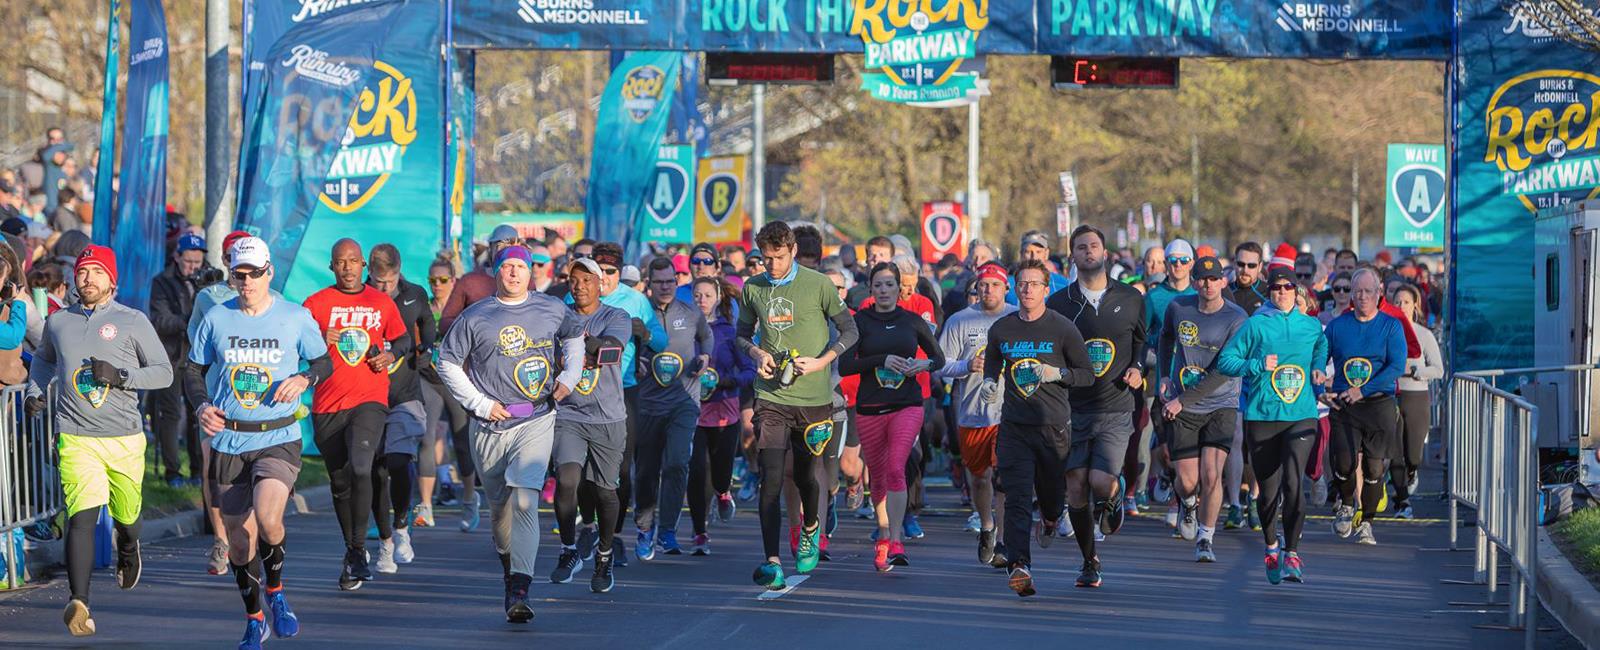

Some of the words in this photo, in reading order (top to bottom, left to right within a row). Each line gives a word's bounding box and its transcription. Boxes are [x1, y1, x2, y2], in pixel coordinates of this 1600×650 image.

[537, 0, 594, 9] BURNS
[1296, 4, 1352, 18] BURNS
[702, 0, 789, 31] ROCK
[1051, 0, 1216, 36] PARKWAY
[868, 31, 972, 67] PARKWAY
[282, 44, 361, 86] Running
[924, 67, 935, 79] 5K
[878, 84, 890, 96] 10
[892, 85, 918, 100] Years
[919, 86, 960, 99] Running
[1539, 79, 1567, 91] BURNS
[1568, 79, 1574, 91] &
[1534, 92, 1579, 103] McDONNELL
[658, 146, 679, 160] AVE
[1404, 148, 1438, 162] WAVE
[1549, 143, 1564, 153] THE
[653, 172, 674, 210] A
[711, 181, 730, 215] B
[1408, 174, 1431, 213] A
[1538, 198, 1552, 208] 13.1
[936, 217, 952, 243] D
[328, 312, 373, 328] run
[228, 335, 279, 349] Team
[1012, 341, 1035, 350] LIGA
[1038, 341, 1055, 351] KC
[224, 348, 284, 364] RMHC
